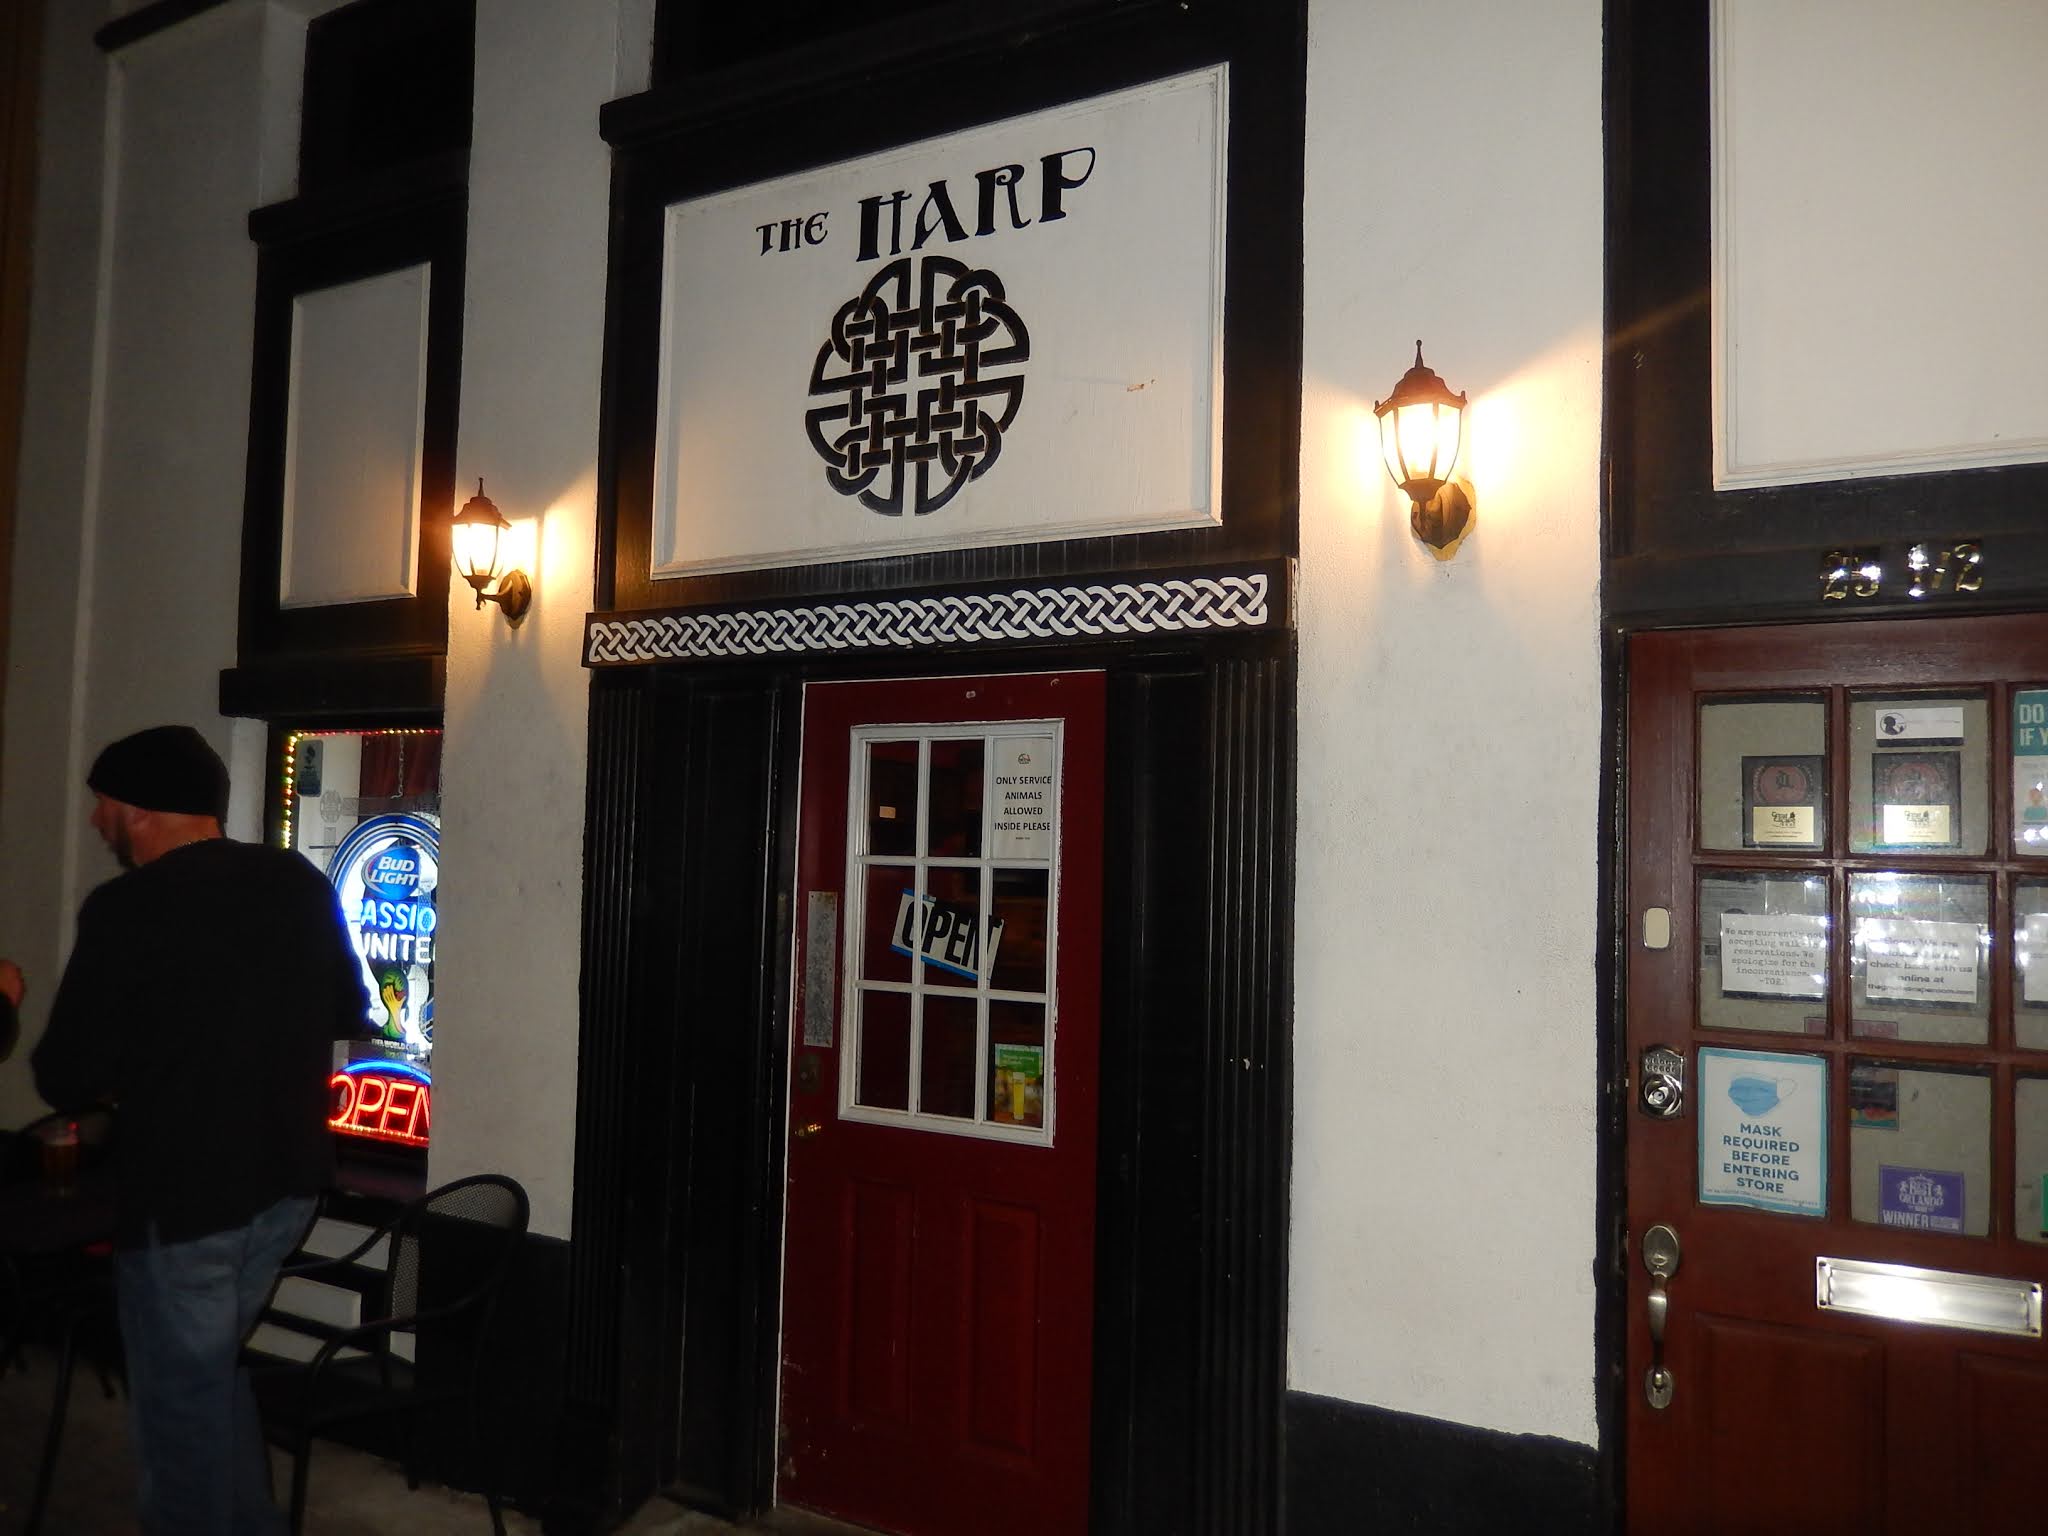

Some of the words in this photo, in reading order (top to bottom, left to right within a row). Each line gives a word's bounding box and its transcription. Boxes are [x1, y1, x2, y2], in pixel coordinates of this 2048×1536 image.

[756, 211, 829, 256] THE
[856, 146, 1096, 262] HARP
[2019, 703, 2045, 724] DO
[2019, 727, 2035, 746] IF
[995, 776, 1018, 785] ONLY
[1019, 775, 1052, 785] SERVICE
[1005, 791, 1042, 800] ANIMALS
[1003, 807, 1043, 815] ALLOWED
[994, 822, 1021, 831] INSIDE
[1023, 822, 1051, 831] PLEASE
[378, 856, 415, 872] BUD
[370, 869, 419, 886] LIGHT
[901, 900, 1003, 972] OPEN
[1740, 1122, 1782, 1137] MASK
[1723, 1135, 1800, 1153] REQUIRED
[1732, 1150, 1790, 1166] BEFORE
[1723, 1163, 1800, 1181] ENTERING
[1736, 1177, 1785, 1193] STORE
[1882, 1209, 1929, 1229] WINNER
